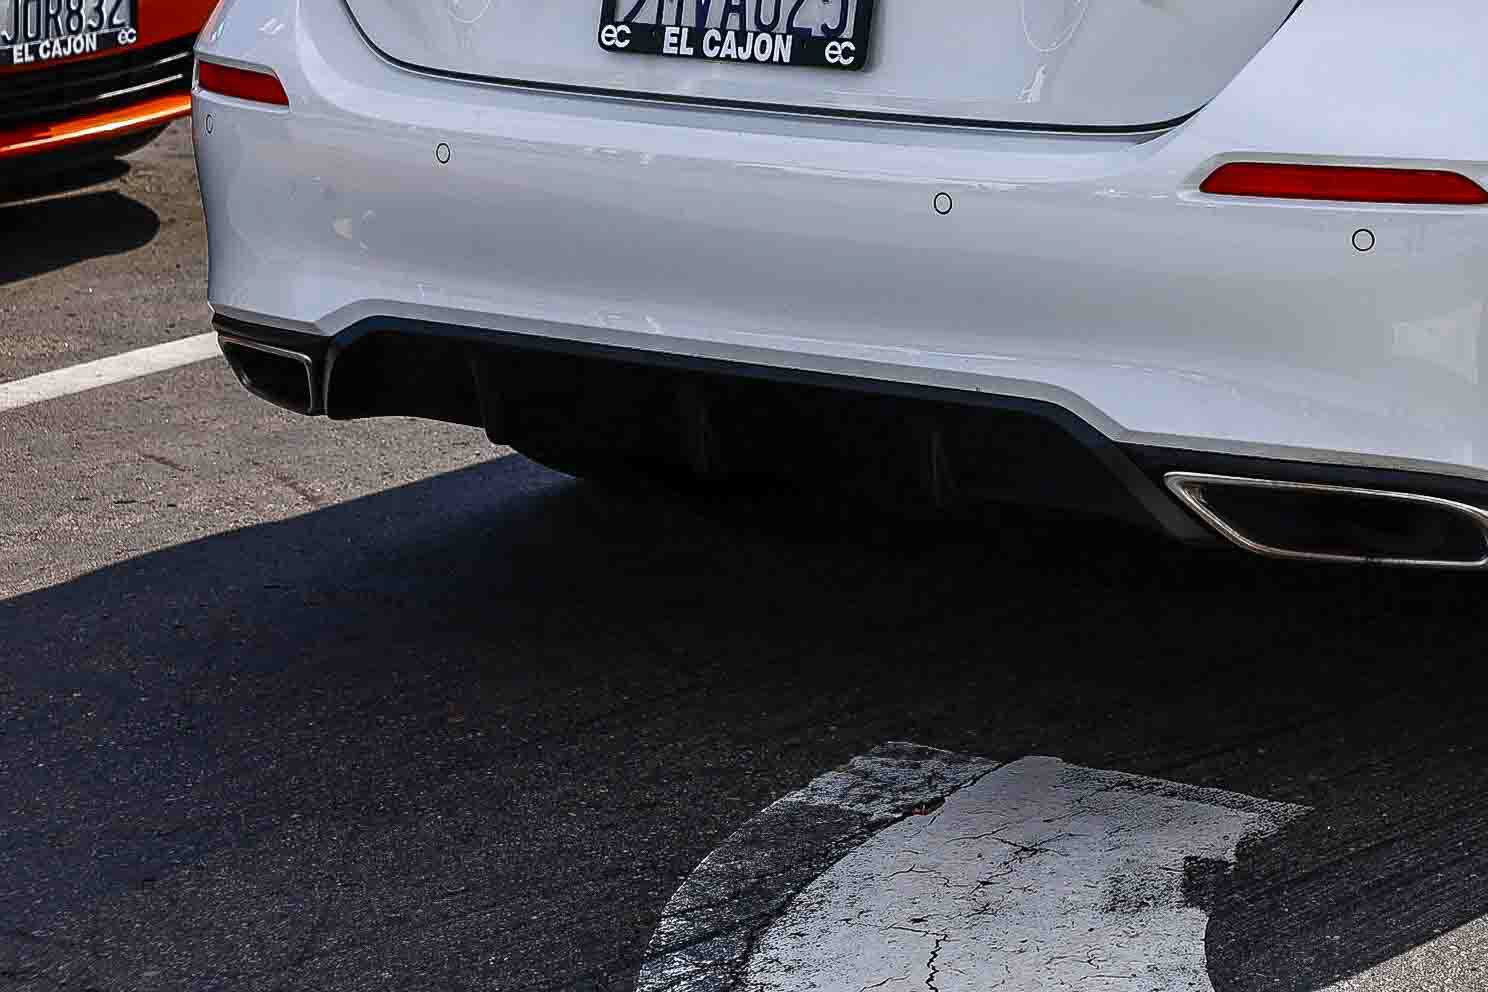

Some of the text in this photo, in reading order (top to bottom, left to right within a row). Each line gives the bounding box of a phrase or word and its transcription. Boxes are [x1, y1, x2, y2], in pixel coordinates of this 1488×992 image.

[13, 33, 97, 65] EL CAJON
[662, 26, 793, 63] EL CAJON
